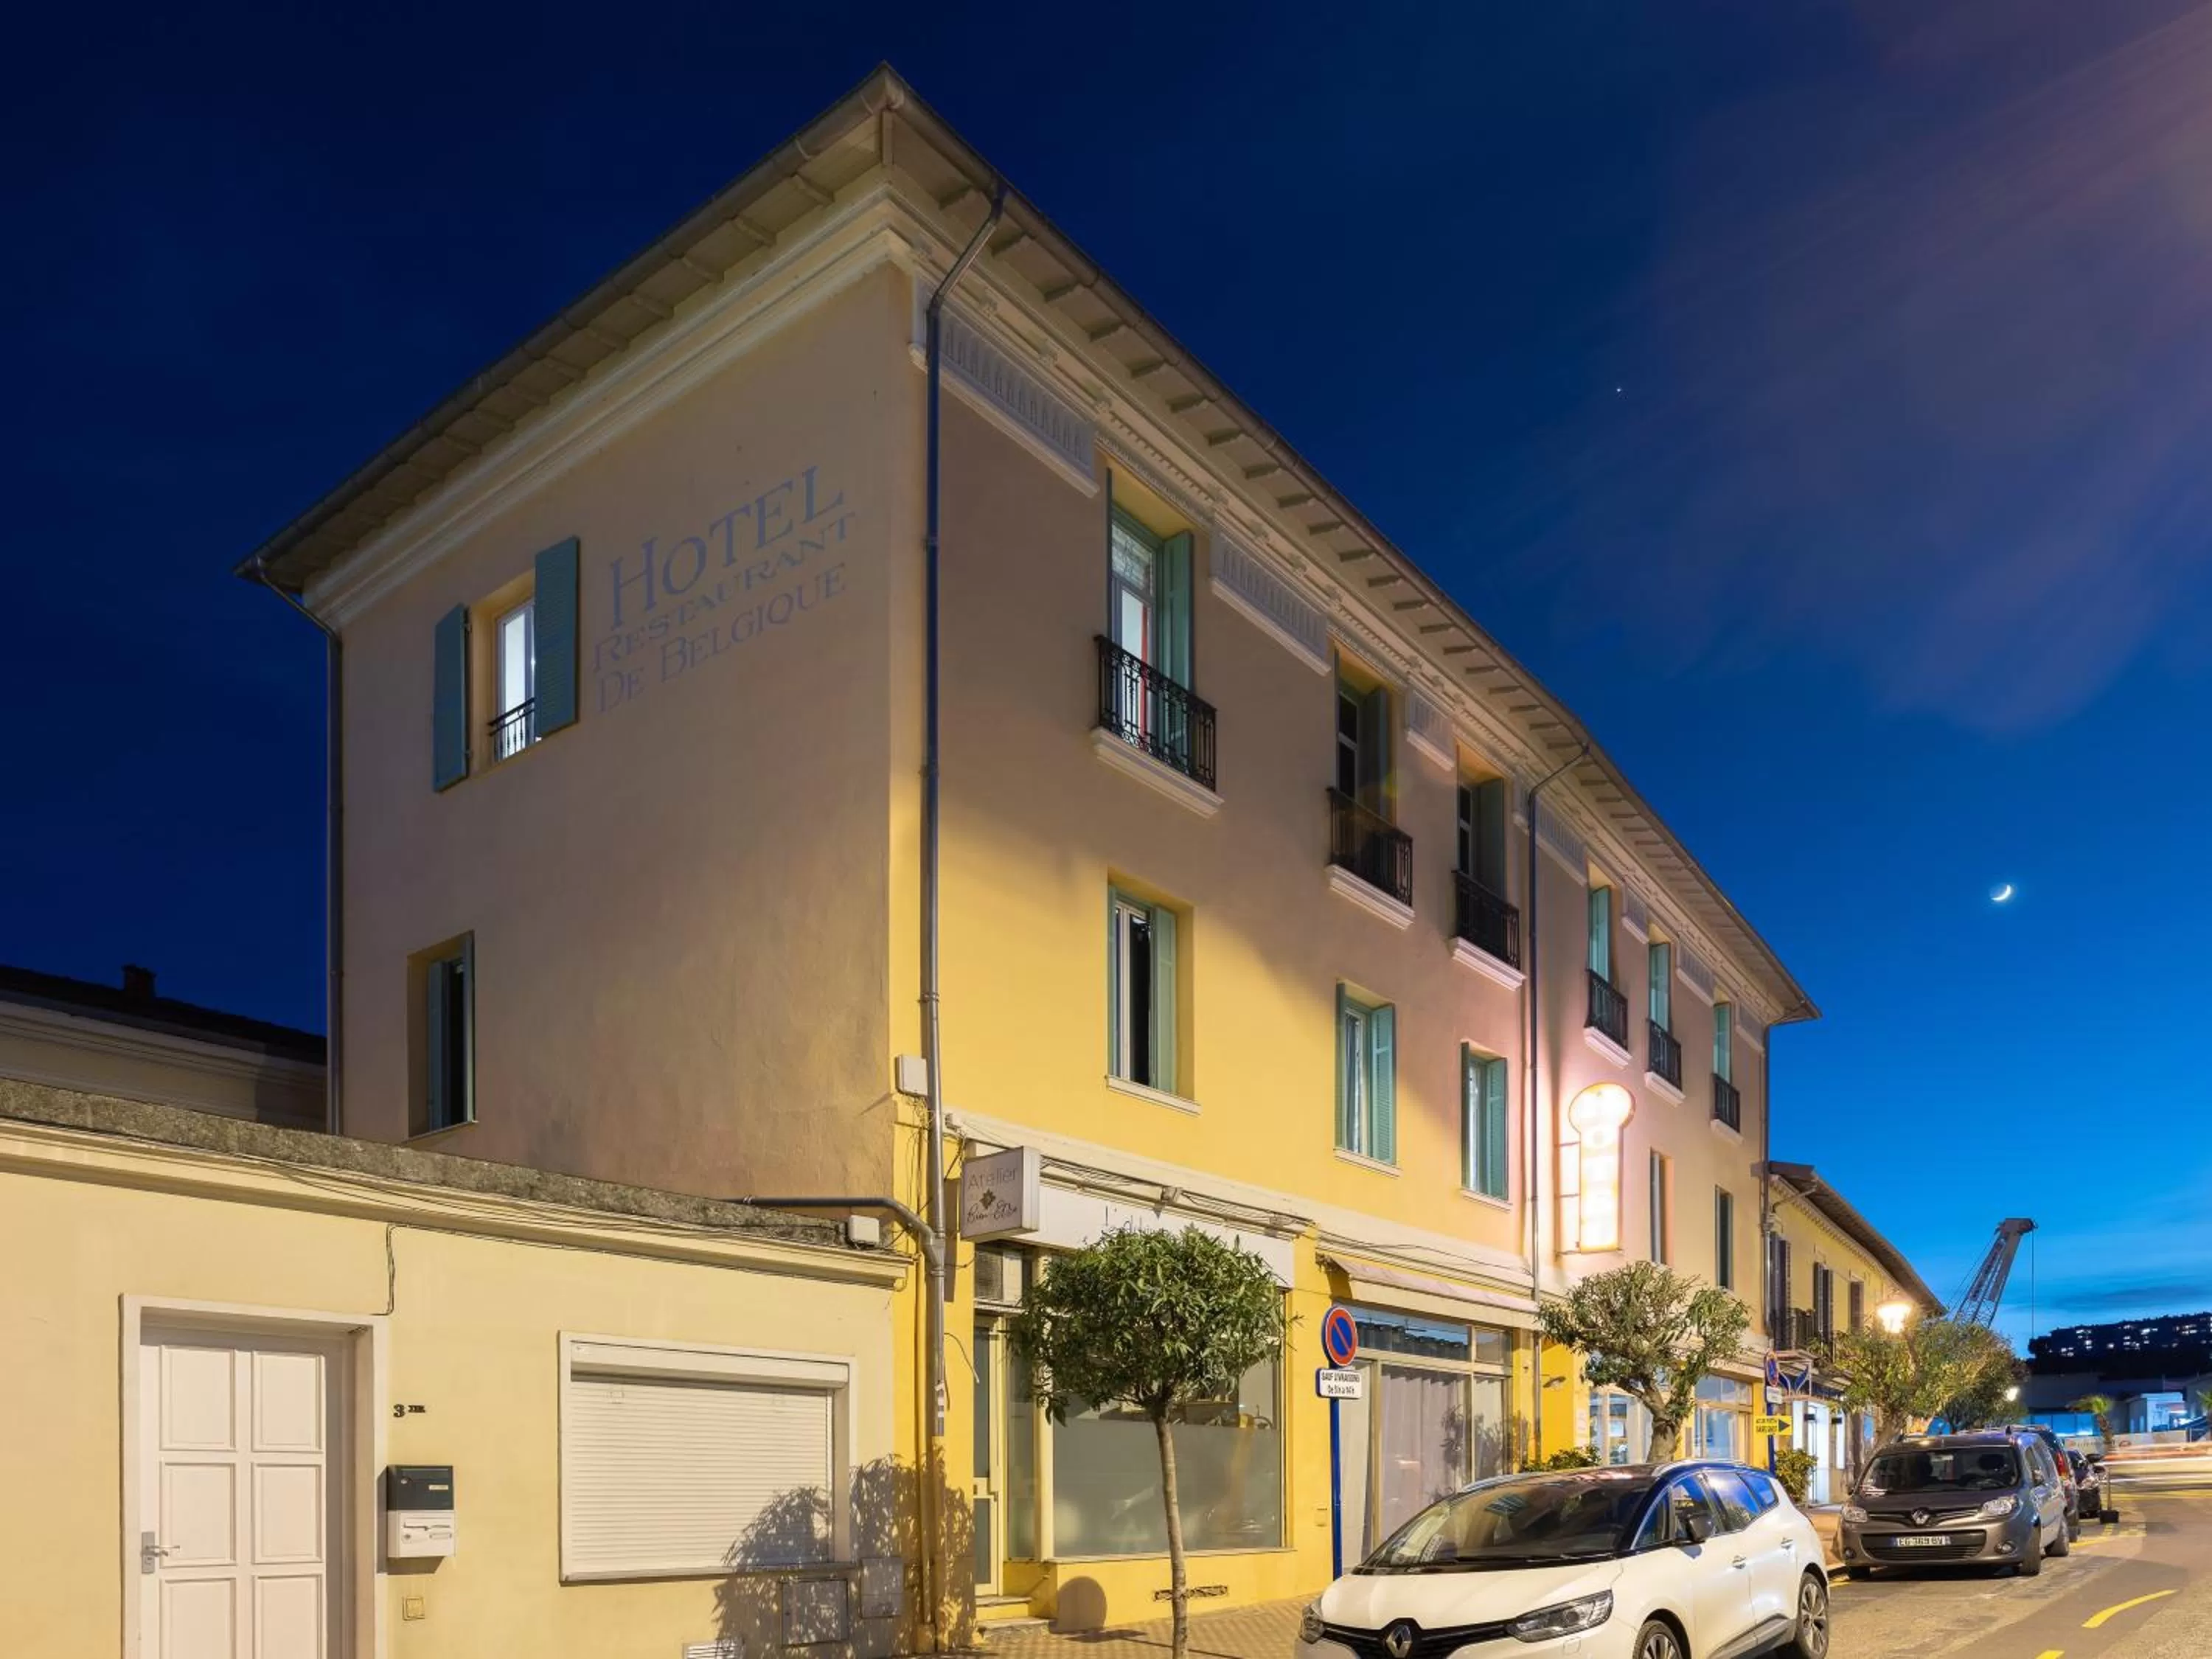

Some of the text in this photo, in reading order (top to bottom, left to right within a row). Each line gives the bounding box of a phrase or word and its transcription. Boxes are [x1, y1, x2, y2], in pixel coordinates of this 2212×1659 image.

[593, 511, 856, 672] RESTAURANT
[611, 465, 845, 632] HOTEL
[599, 562, 846, 714] DE BELGIQUE
[393, 1404, 406, 1418] 3
